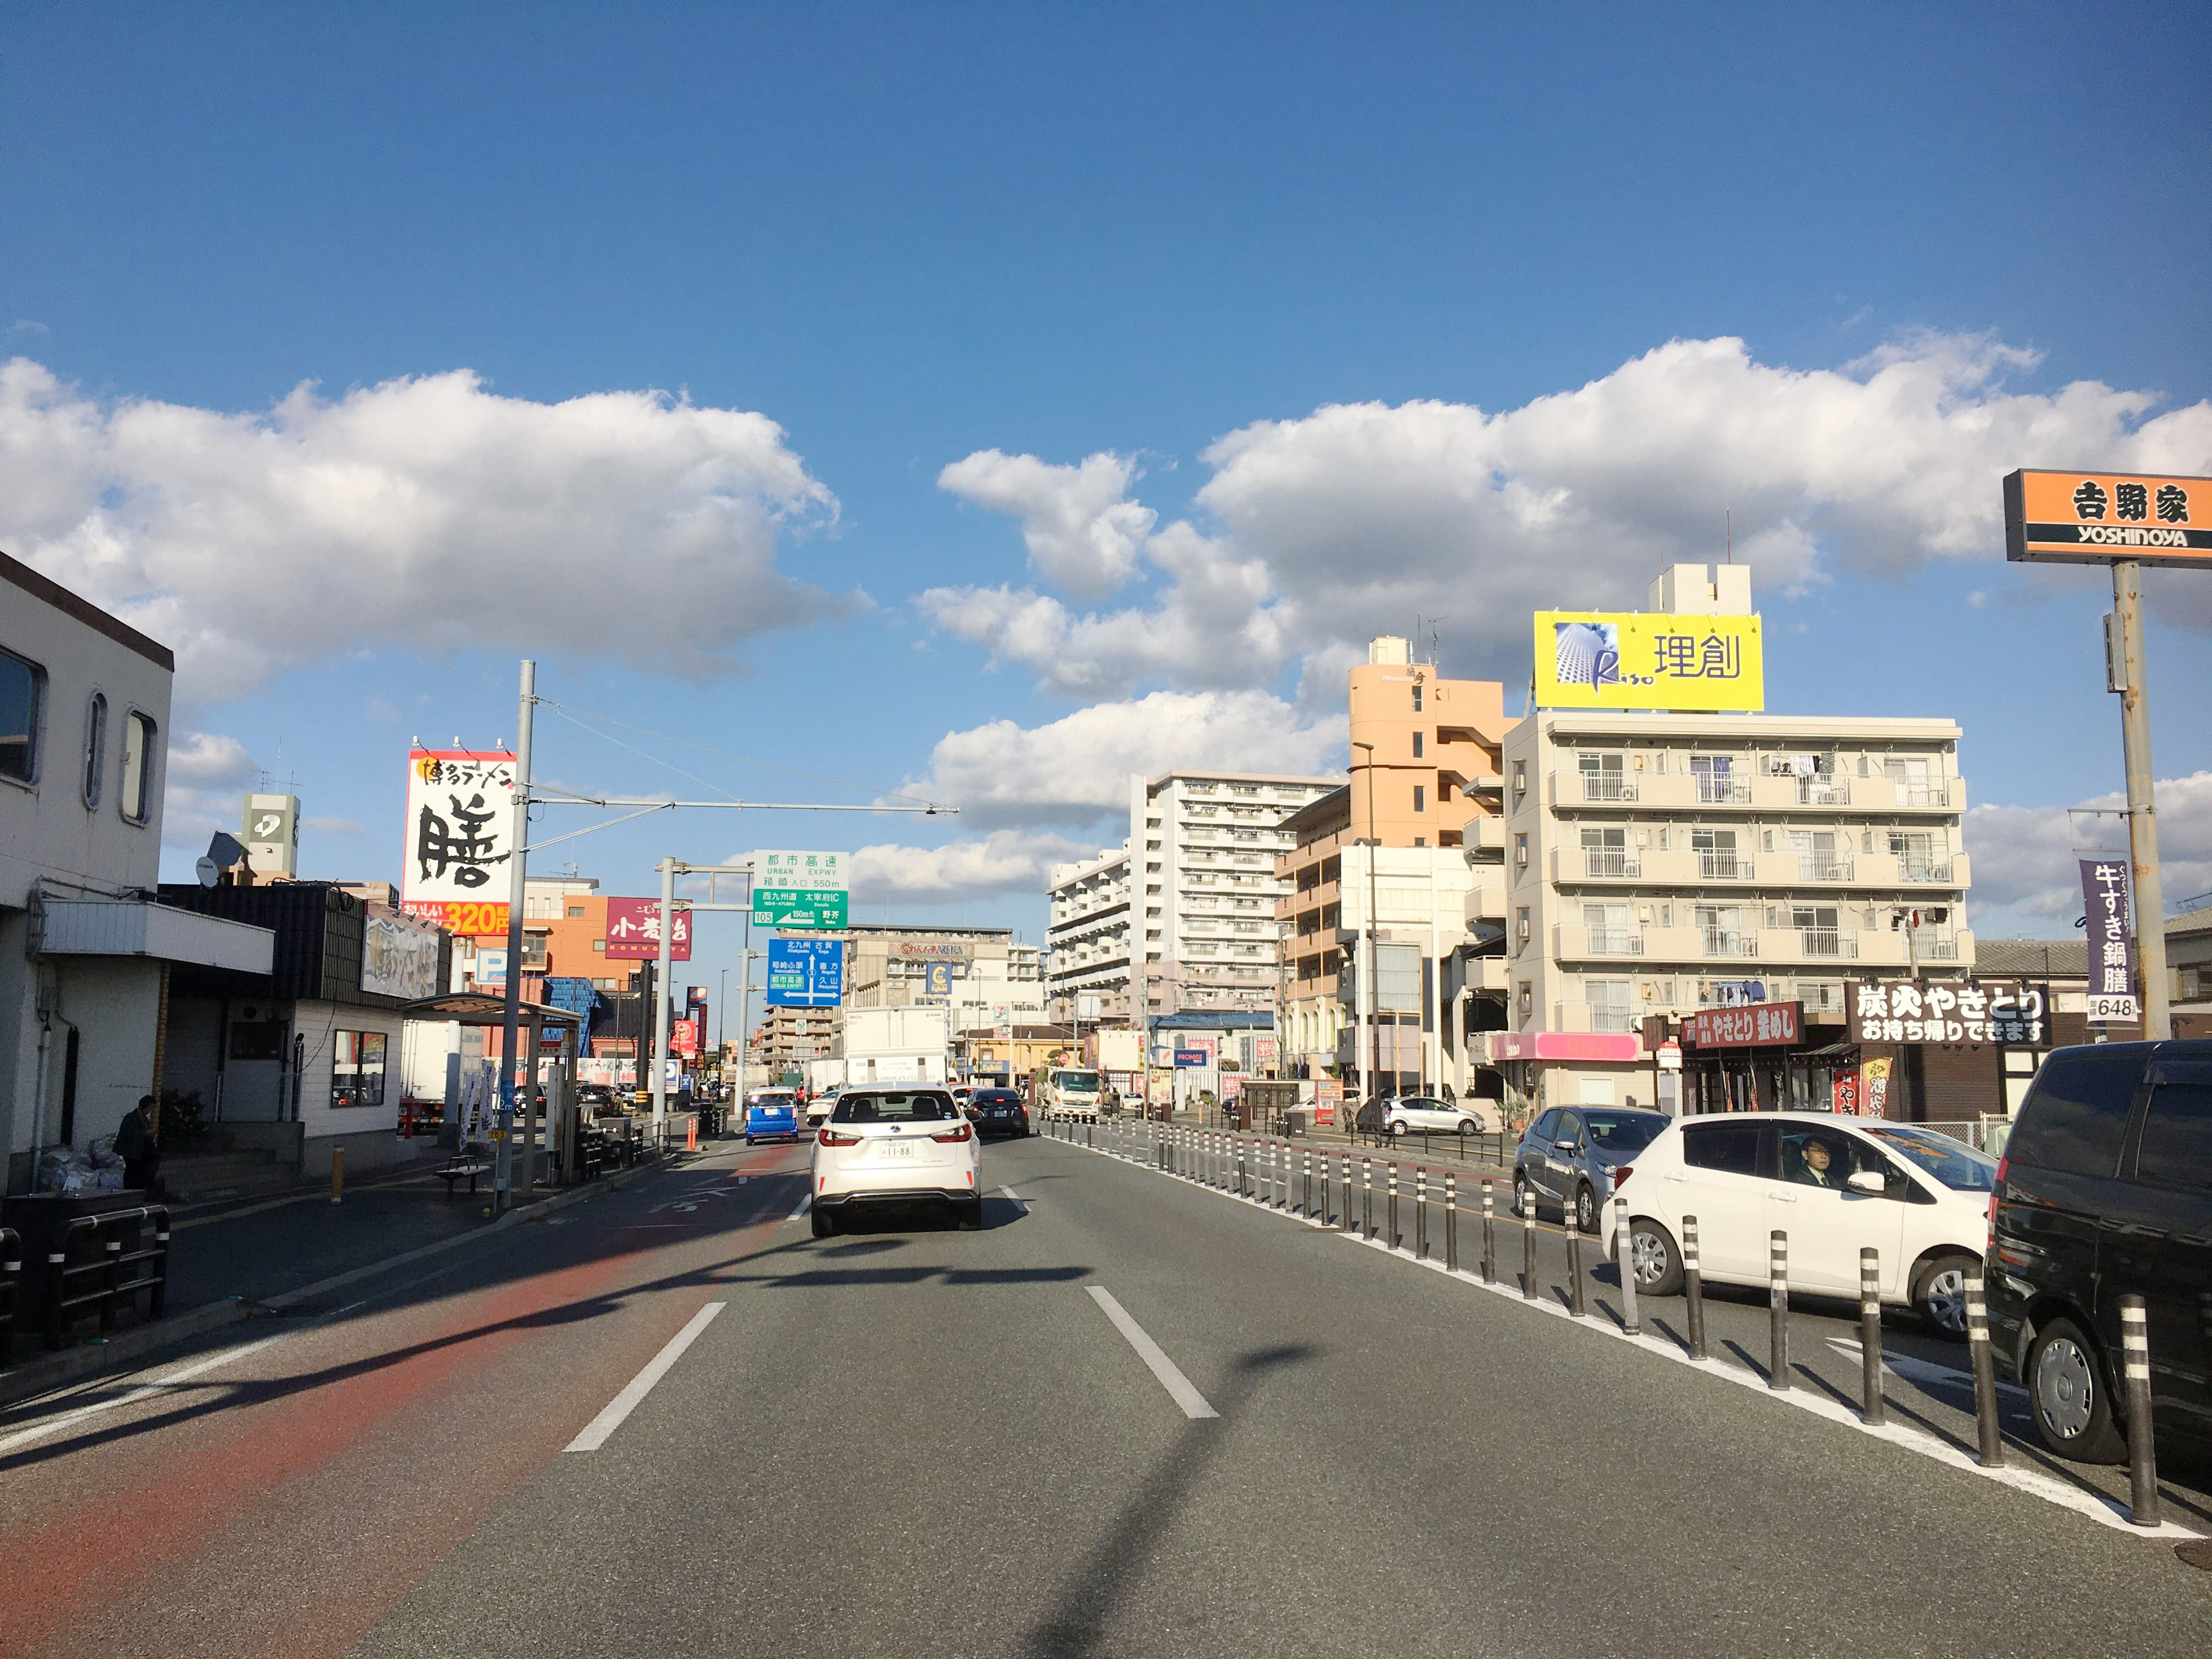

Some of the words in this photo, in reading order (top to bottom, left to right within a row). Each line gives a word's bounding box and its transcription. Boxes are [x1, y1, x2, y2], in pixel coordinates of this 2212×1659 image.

[2073, 481, 2189, 523] 吉野家
[2077, 526, 2188, 547] YOSHINOYA
[1654, 635, 1740, 679] 理創
[1592, 649, 1654, 693] Riso
[423, 758, 512, 788] 博多ラーメン
[418, 793, 511, 888] 膳
[768, 854, 837, 867] 都市高速
[763, 891, 797, 901] 西九州道
[805, 893, 839, 902] 太宰府IC
[445, 902, 496, 933] 320
[755, 913, 772, 922] 105
[792, 910, 815, 918] 150m先
[822, 910, 839, 919] 野芥
[2095, 865, 2128, 993] 牛すき鍋膳
[479, 951, 508, 981] P
[819, 977, 838, 985] 久山
[1857, 985, 2044, 1019] 炭火やきとり
[2098, 1000, 2131, 1016] 648
[1712, 1012, 1753, 1042] やきとり
[1862, 1019, 2044, 1042] お持ち帰りできます
[1566, 1044, 1611, 1057] HIRO
[888, 1147, 910, 1156] 11-88
